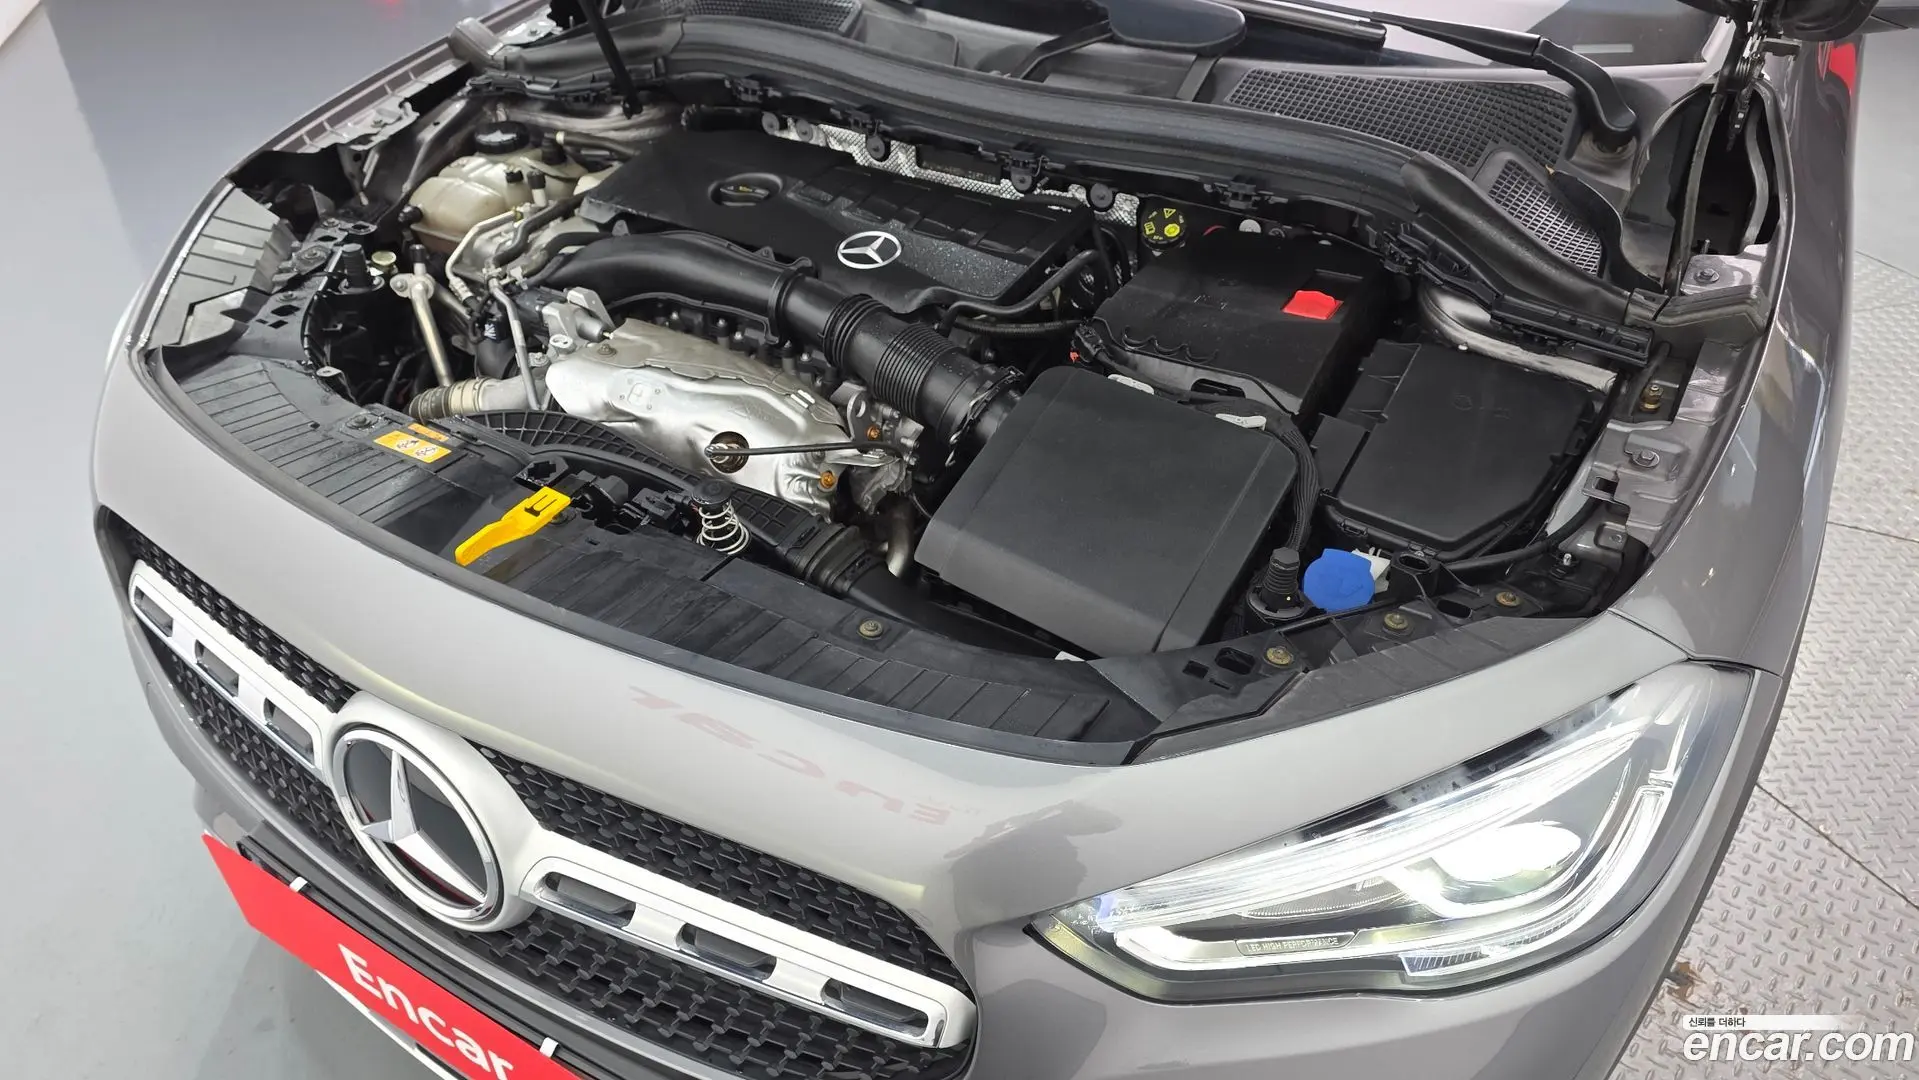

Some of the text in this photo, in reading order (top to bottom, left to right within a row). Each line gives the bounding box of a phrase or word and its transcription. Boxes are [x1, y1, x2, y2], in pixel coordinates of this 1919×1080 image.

[1262, 941, 1281, 951] HIGH
[1282, 938, 1338, 949] PERFORMANCE
[338, 943, 514, 1080] Encar
